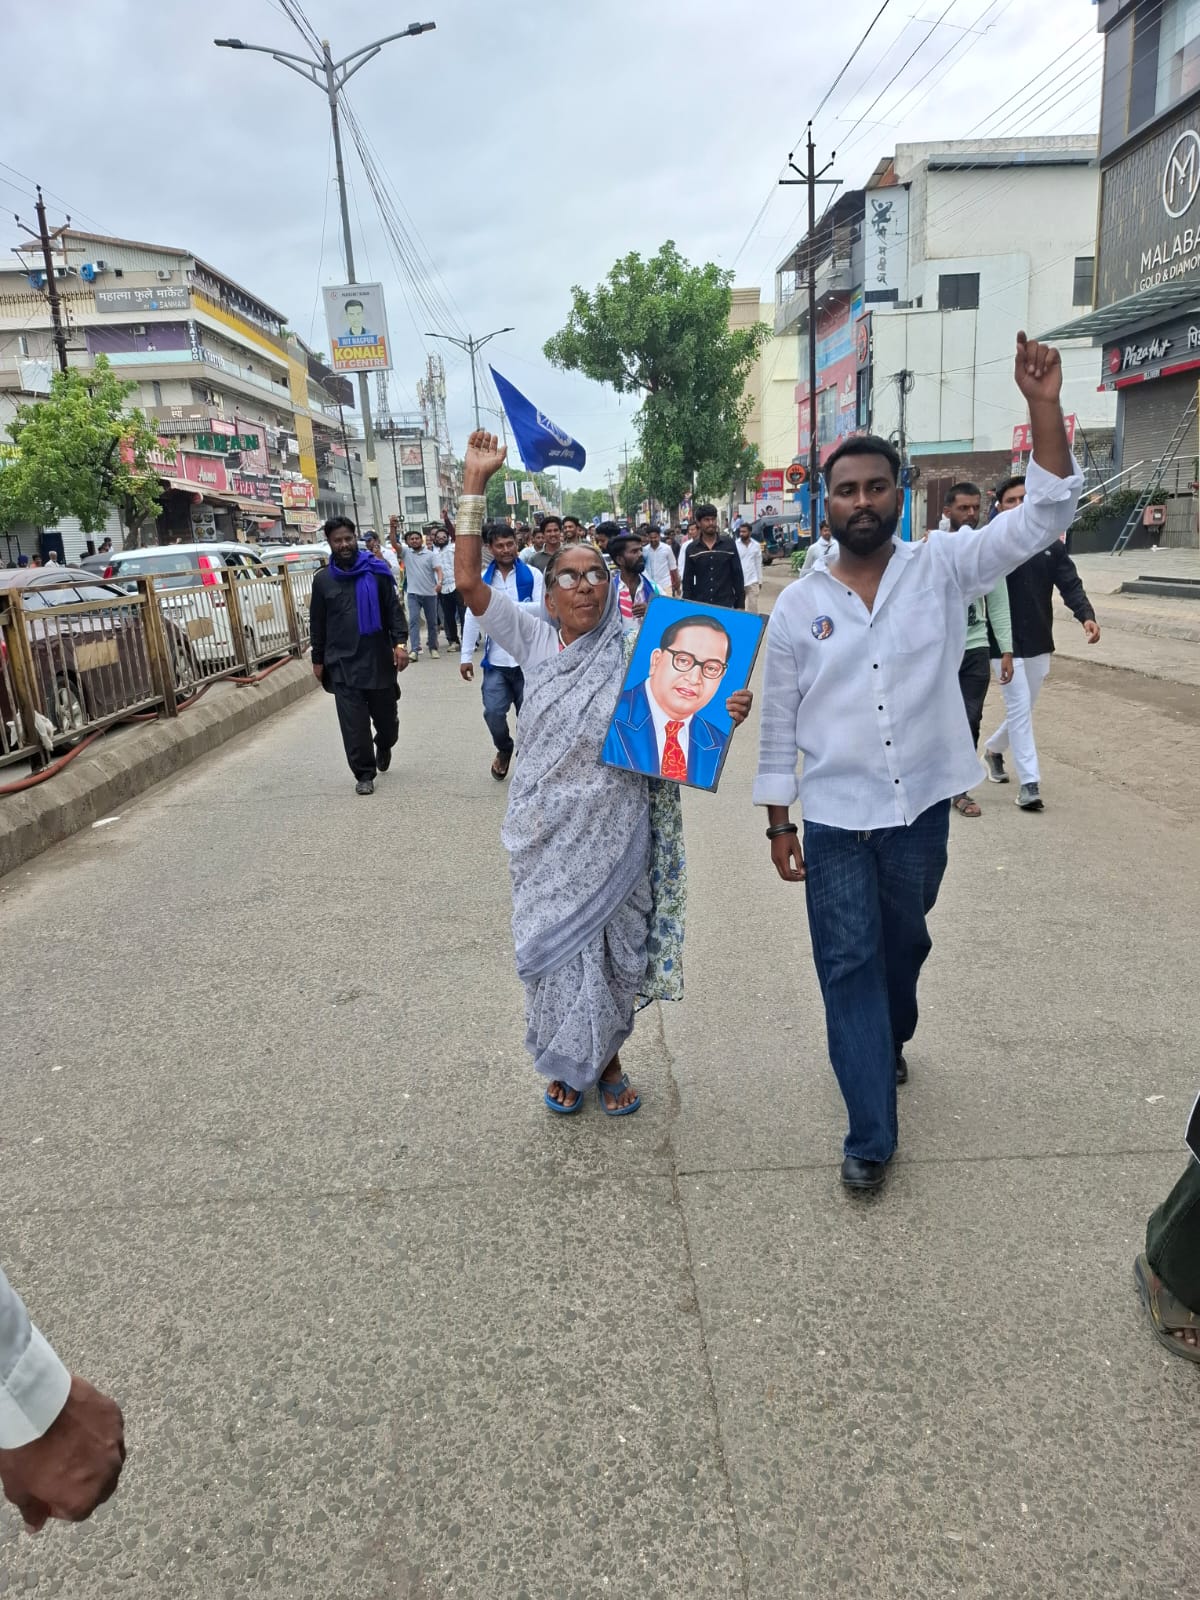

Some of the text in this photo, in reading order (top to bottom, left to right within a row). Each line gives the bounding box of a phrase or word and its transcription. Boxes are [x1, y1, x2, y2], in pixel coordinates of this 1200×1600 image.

[1140, 272, 1161, 291] GOLD
[1162, 268, 1169, 282] &
[98, 286, 185, 303] महात्मा फुले मार्केट
[188, 320, 199, 361] TATTOO
[334, 345, 385, 361] KONALE
[1122, 337, 1172, 370] Pizza Hut
[349, 358, 385, 368] CENTRE
[195, 434, 259, 451] KHAN
